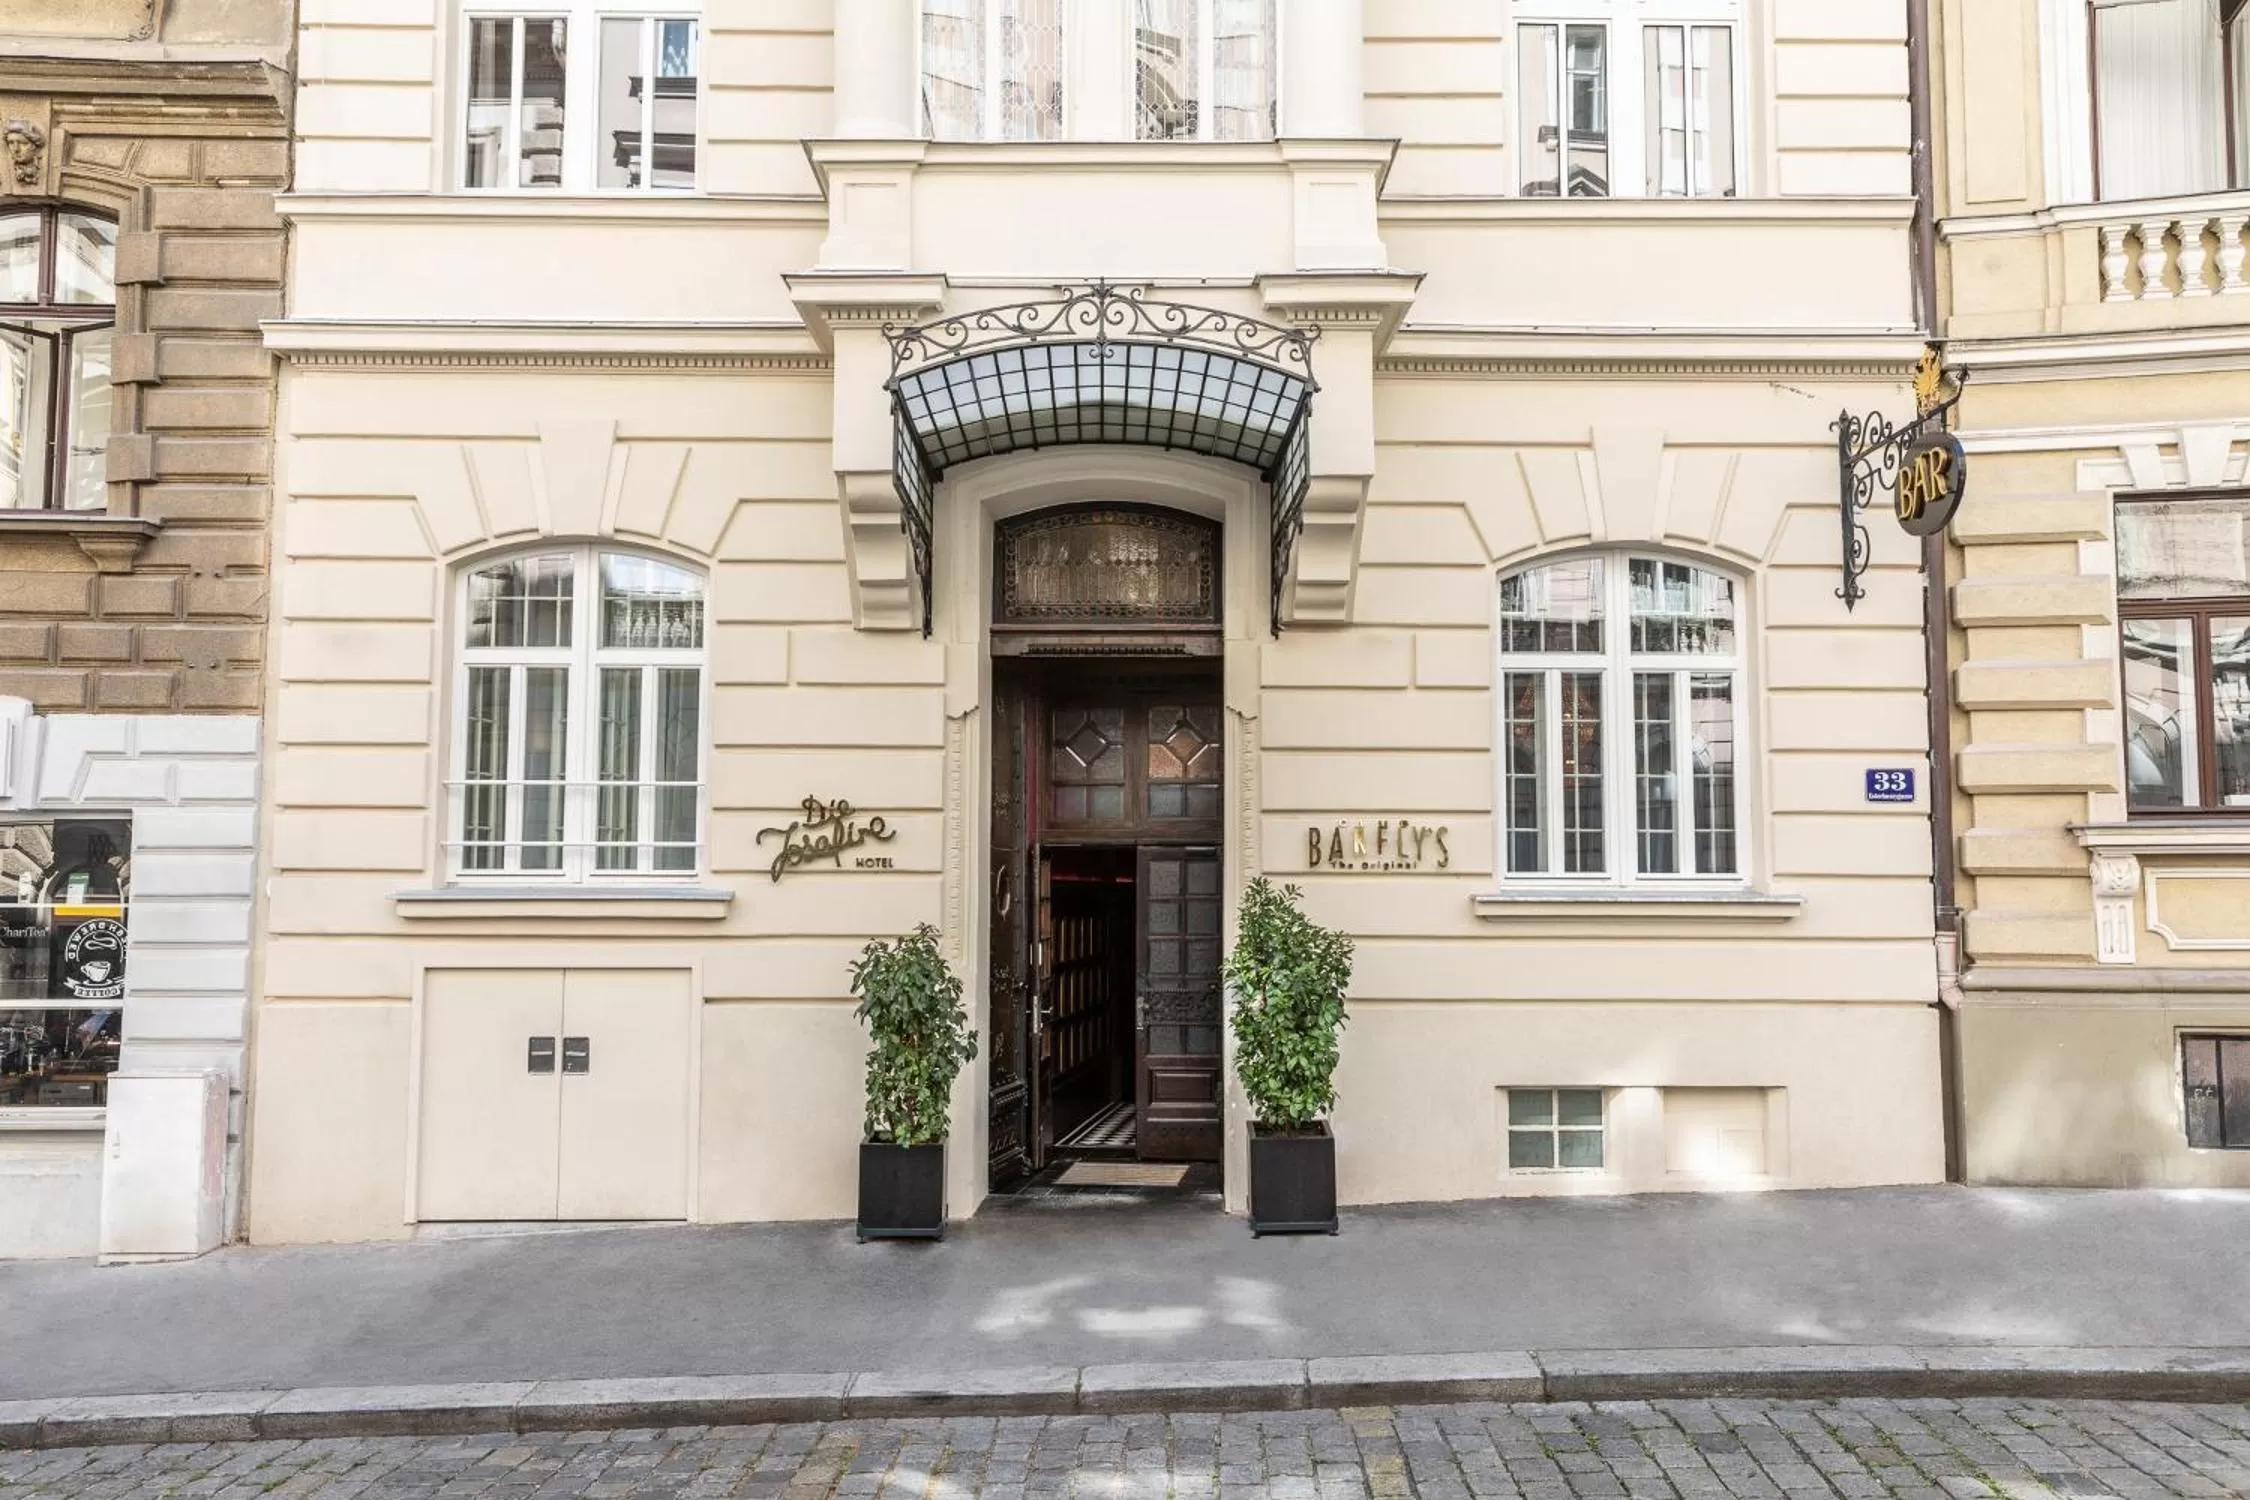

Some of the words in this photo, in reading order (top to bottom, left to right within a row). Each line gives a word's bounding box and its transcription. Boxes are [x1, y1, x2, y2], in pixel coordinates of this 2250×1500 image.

[1899, 447, 1951, 519] BAR
[1874, 772, 1907, 791] 33
[802, 794, 856, 827] Die
[756, 816, 897, 883] Josefine
[856, 857, 894, 869] HOTEL
[1331, 861, 1354, 870] The
[1361, 861, 1417, 871] Original
